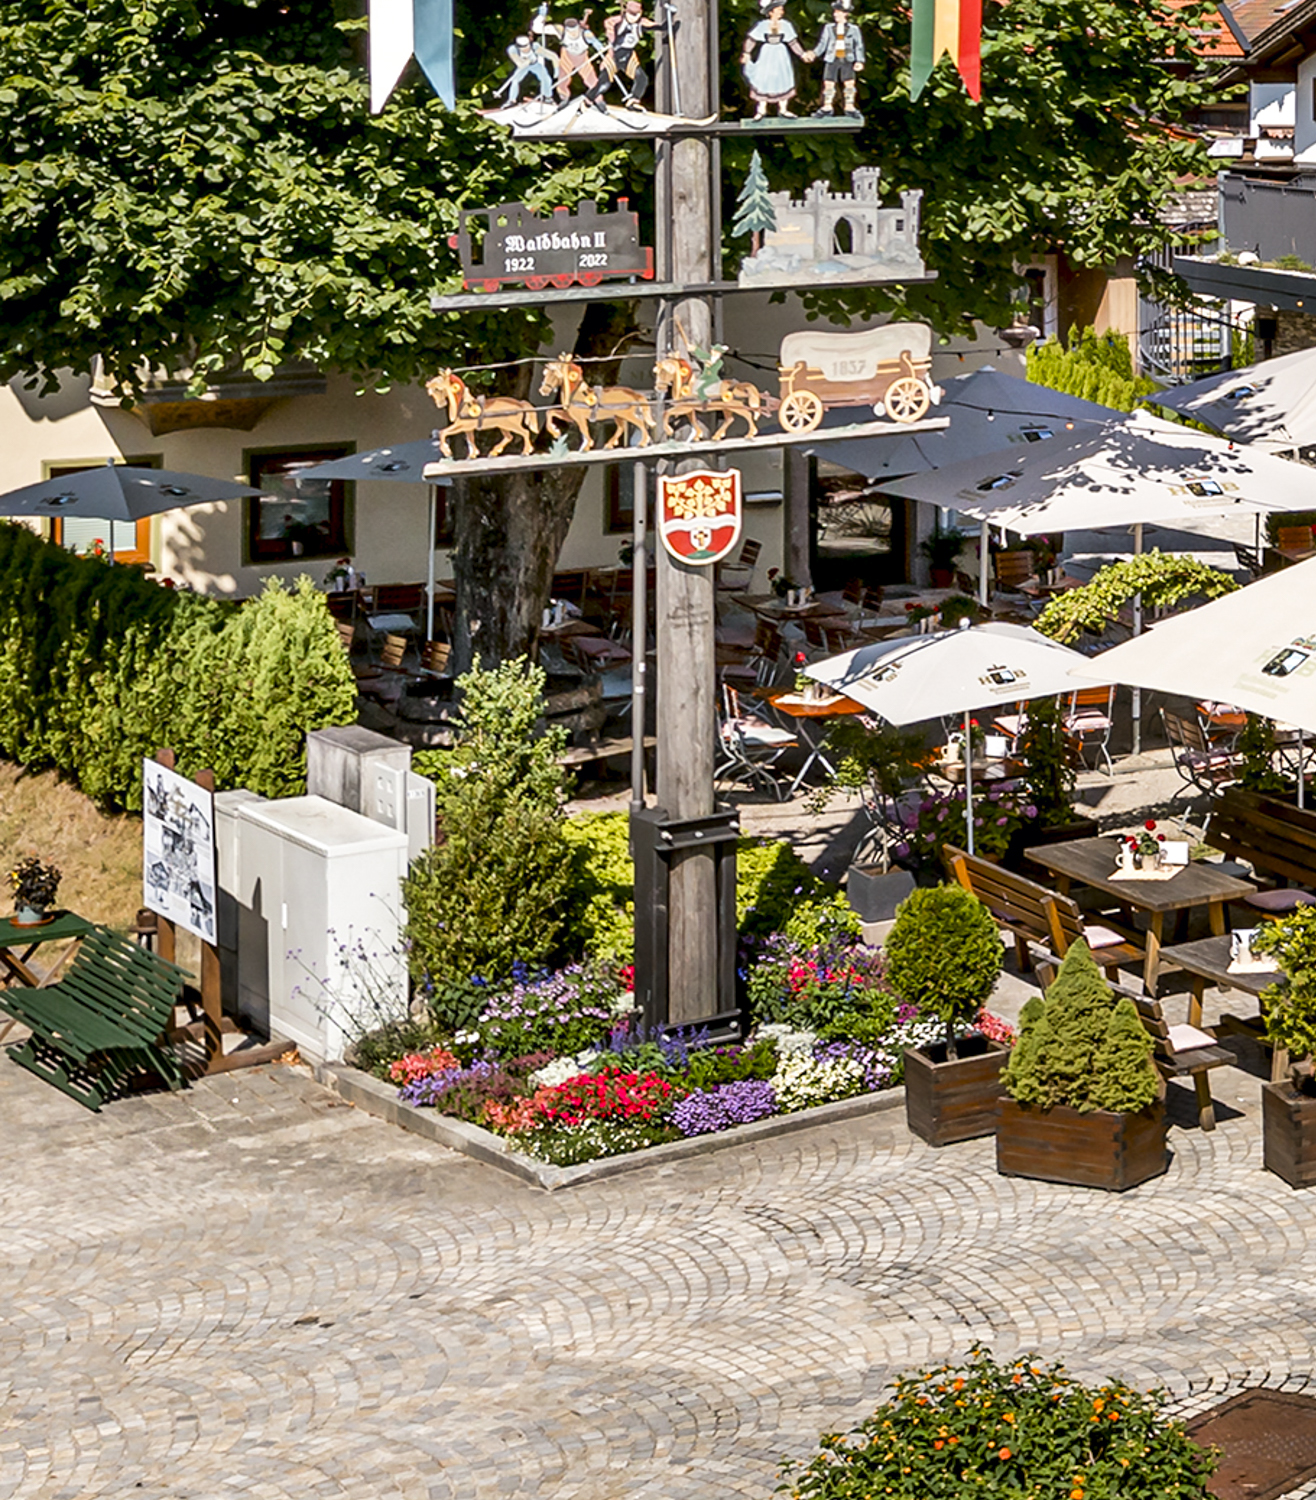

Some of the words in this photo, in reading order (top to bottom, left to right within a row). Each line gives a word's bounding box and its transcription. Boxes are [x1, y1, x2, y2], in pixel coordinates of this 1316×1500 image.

[504, 233, 592, 253] Waldbahn
[593, 231, 607, 248] II
[504, 257, 536, 273] 1922
[578, 253, 608, 268] 2022
